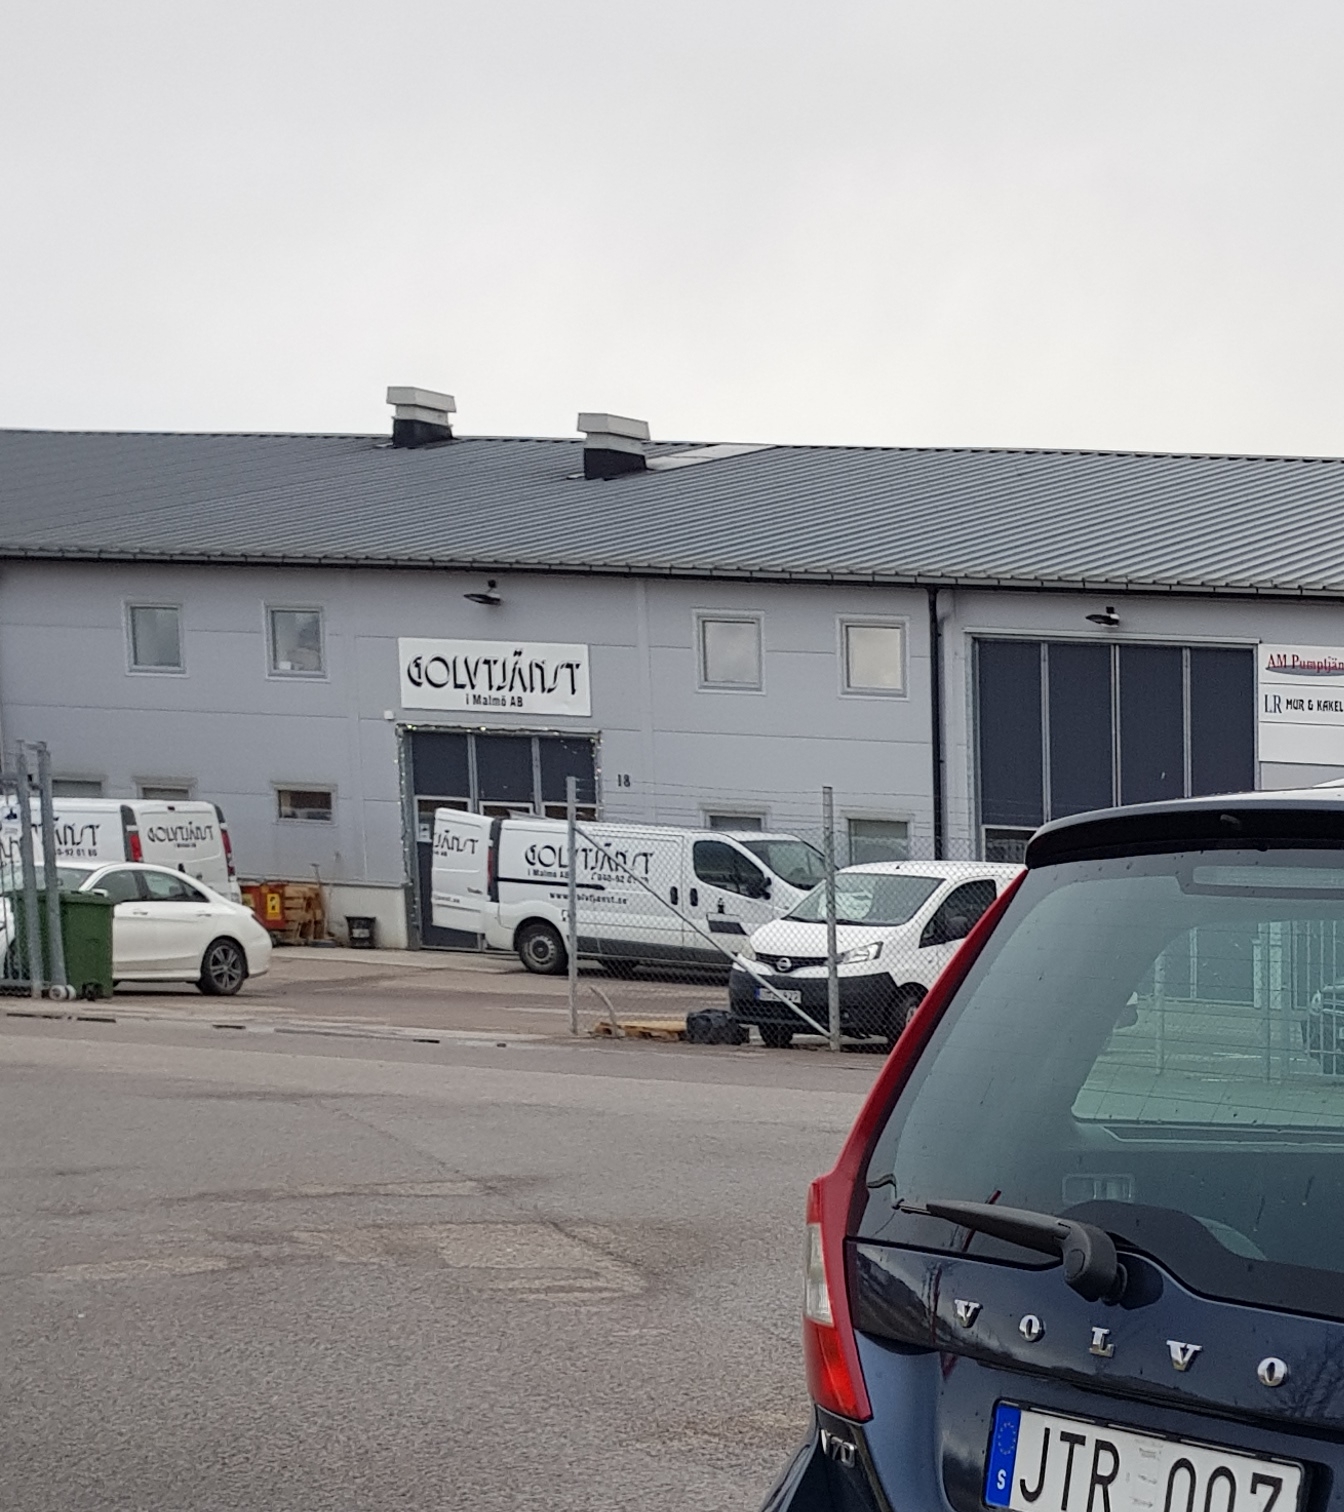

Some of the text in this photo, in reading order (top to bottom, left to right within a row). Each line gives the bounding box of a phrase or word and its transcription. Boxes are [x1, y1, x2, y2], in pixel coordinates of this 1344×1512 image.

[1267, 653, 1287, 668] AM
[406, 648, 581, 696] GOLVTJÄNST
[473, 694, 506, 707] Malmö
[510, 696, 523, 707] AB
[1264, 694, 1282, 713] LR
[1285, 698, 1304, 711] MUR
[1307, 699, 1314, 711] &
[1316, 700, 1343, 713] KAKEL
[617, 773, 631, 787] 18
[524, 842, 653, 874] GOLTJÄNST
[953, 1299, 1290, 1388] VOLVO
[820, 1429, 856, 1468] V70
[996, 1469, 1006, 1490] S
